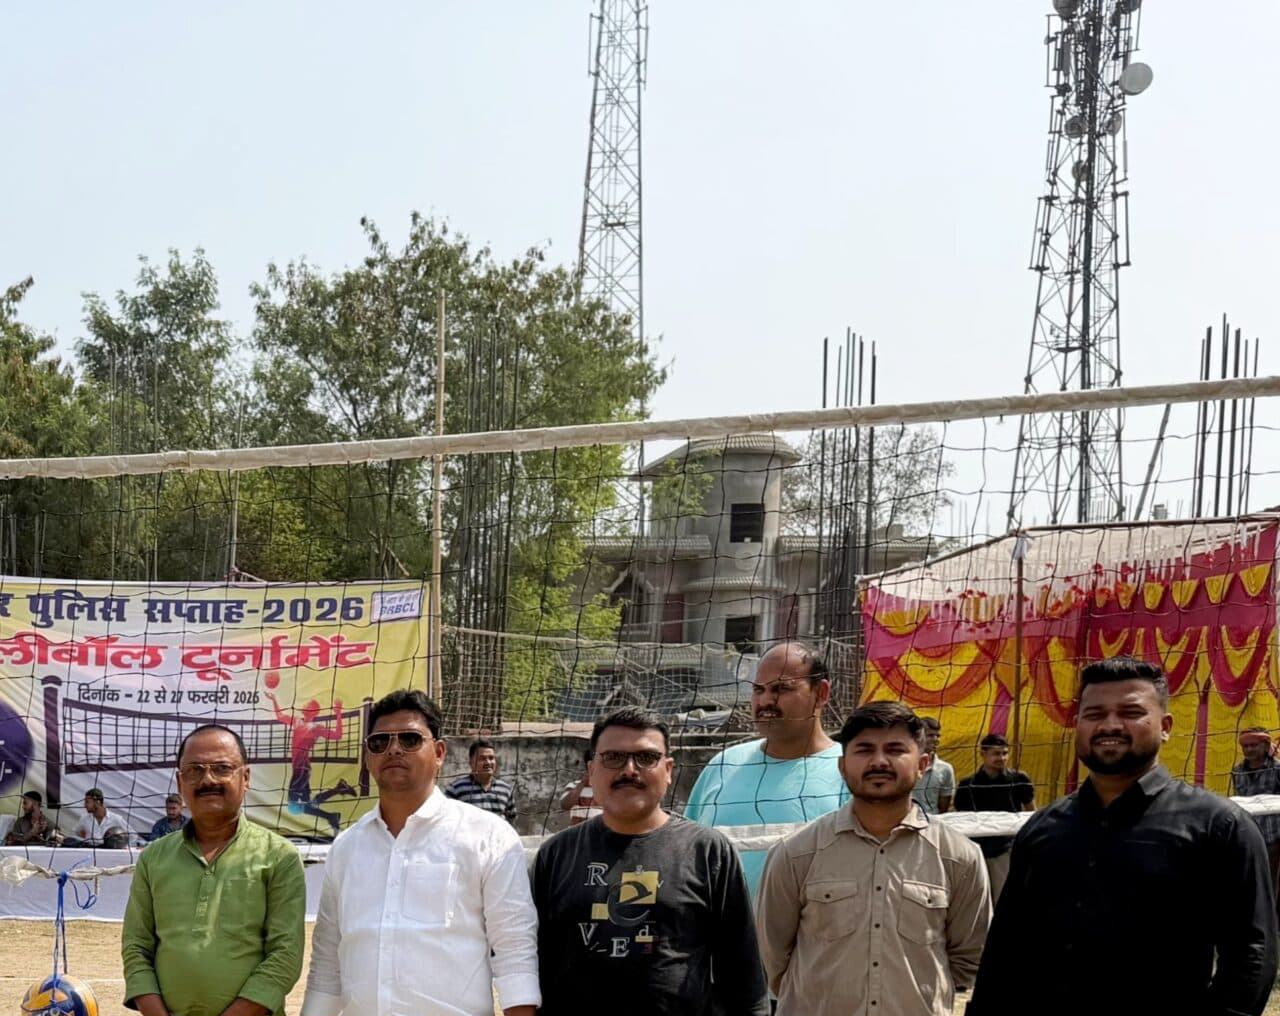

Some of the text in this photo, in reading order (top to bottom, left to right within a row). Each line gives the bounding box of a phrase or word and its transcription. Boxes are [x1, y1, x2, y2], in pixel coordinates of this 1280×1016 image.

[27, 589, 129, 628] पुलिस
[142, 597, 365, 624] सप्ताह-2026
[179, 635, 375, 681] टूर्नामेंट
[78, 683, 121, 703] दिनांक
[137, 690, 150, 703] 22
[154, 686, 167, 704] से
[233, 691, 260, 704] 2026
